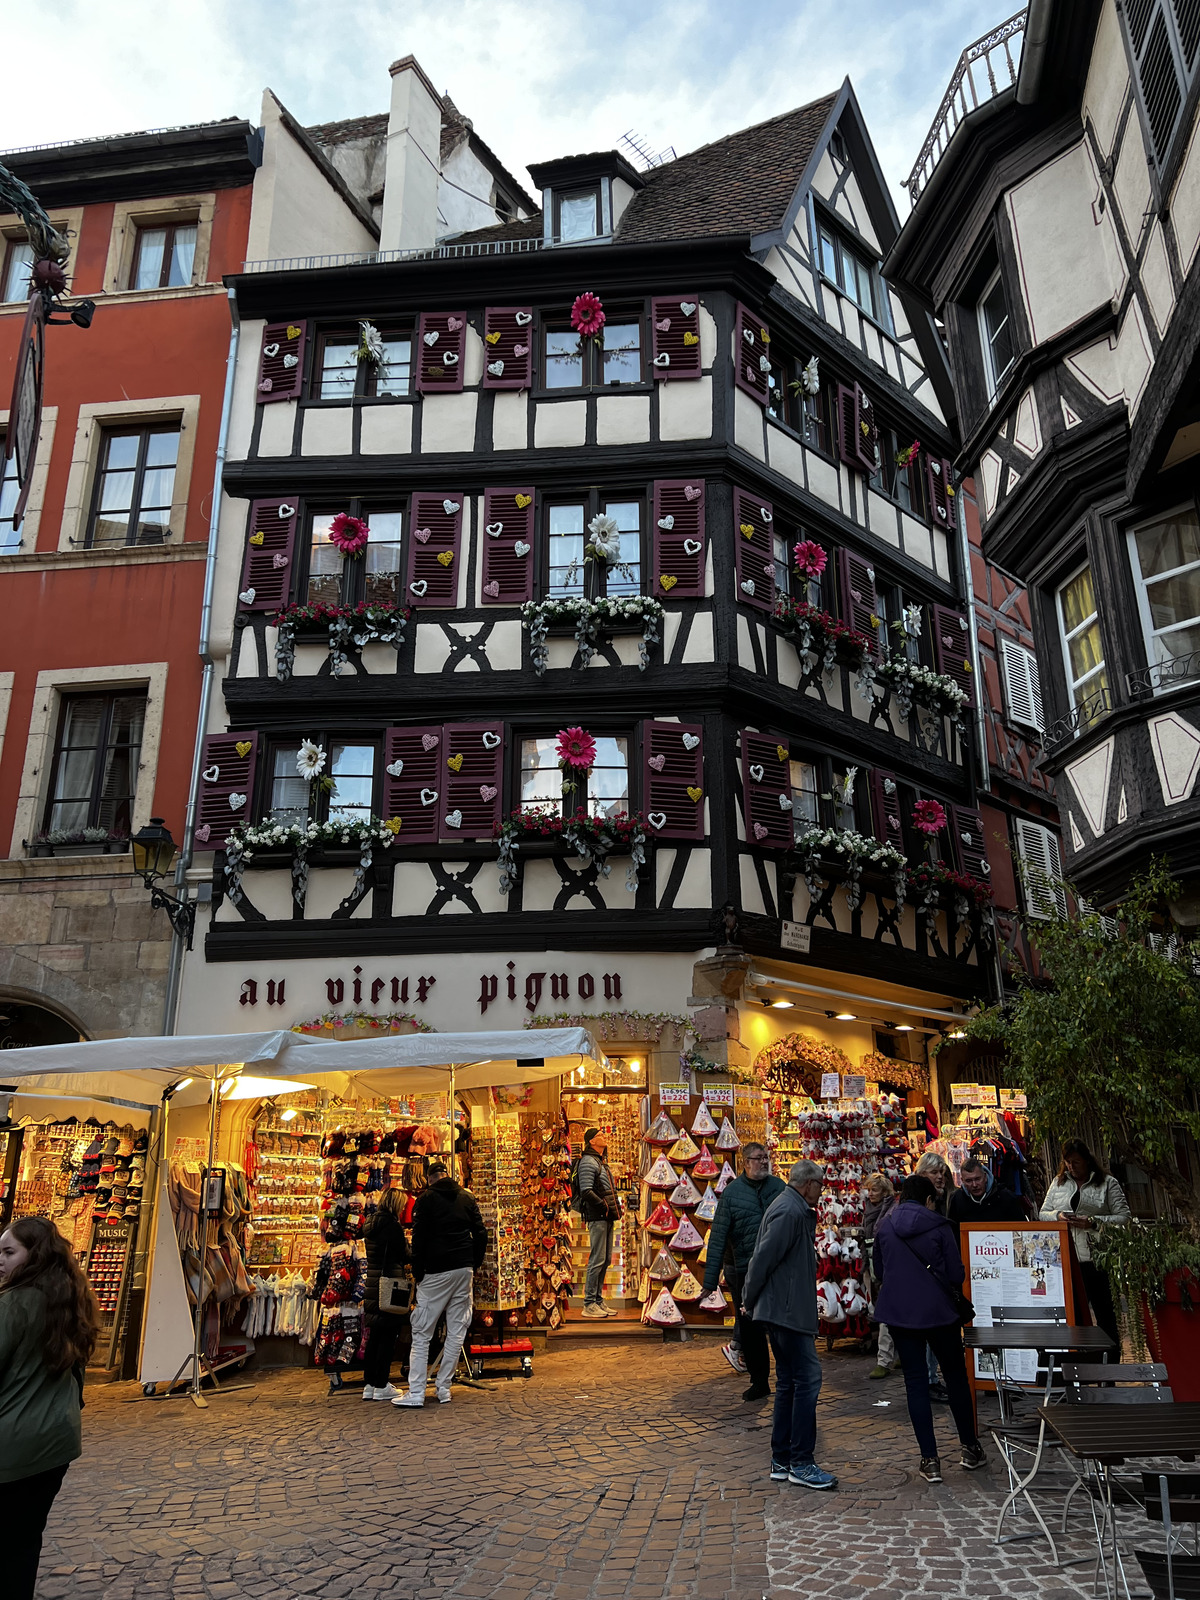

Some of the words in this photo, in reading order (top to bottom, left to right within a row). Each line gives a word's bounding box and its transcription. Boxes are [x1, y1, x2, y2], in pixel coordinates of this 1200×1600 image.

[238, 977, 286, 1007] au
[325, 964, 437, 1006] vieux
[477, 960, 623, 1015] pignon
[99, 1229, 128, 1238] MUSIC
[975, 1244, 1009, 1256] Hansi
